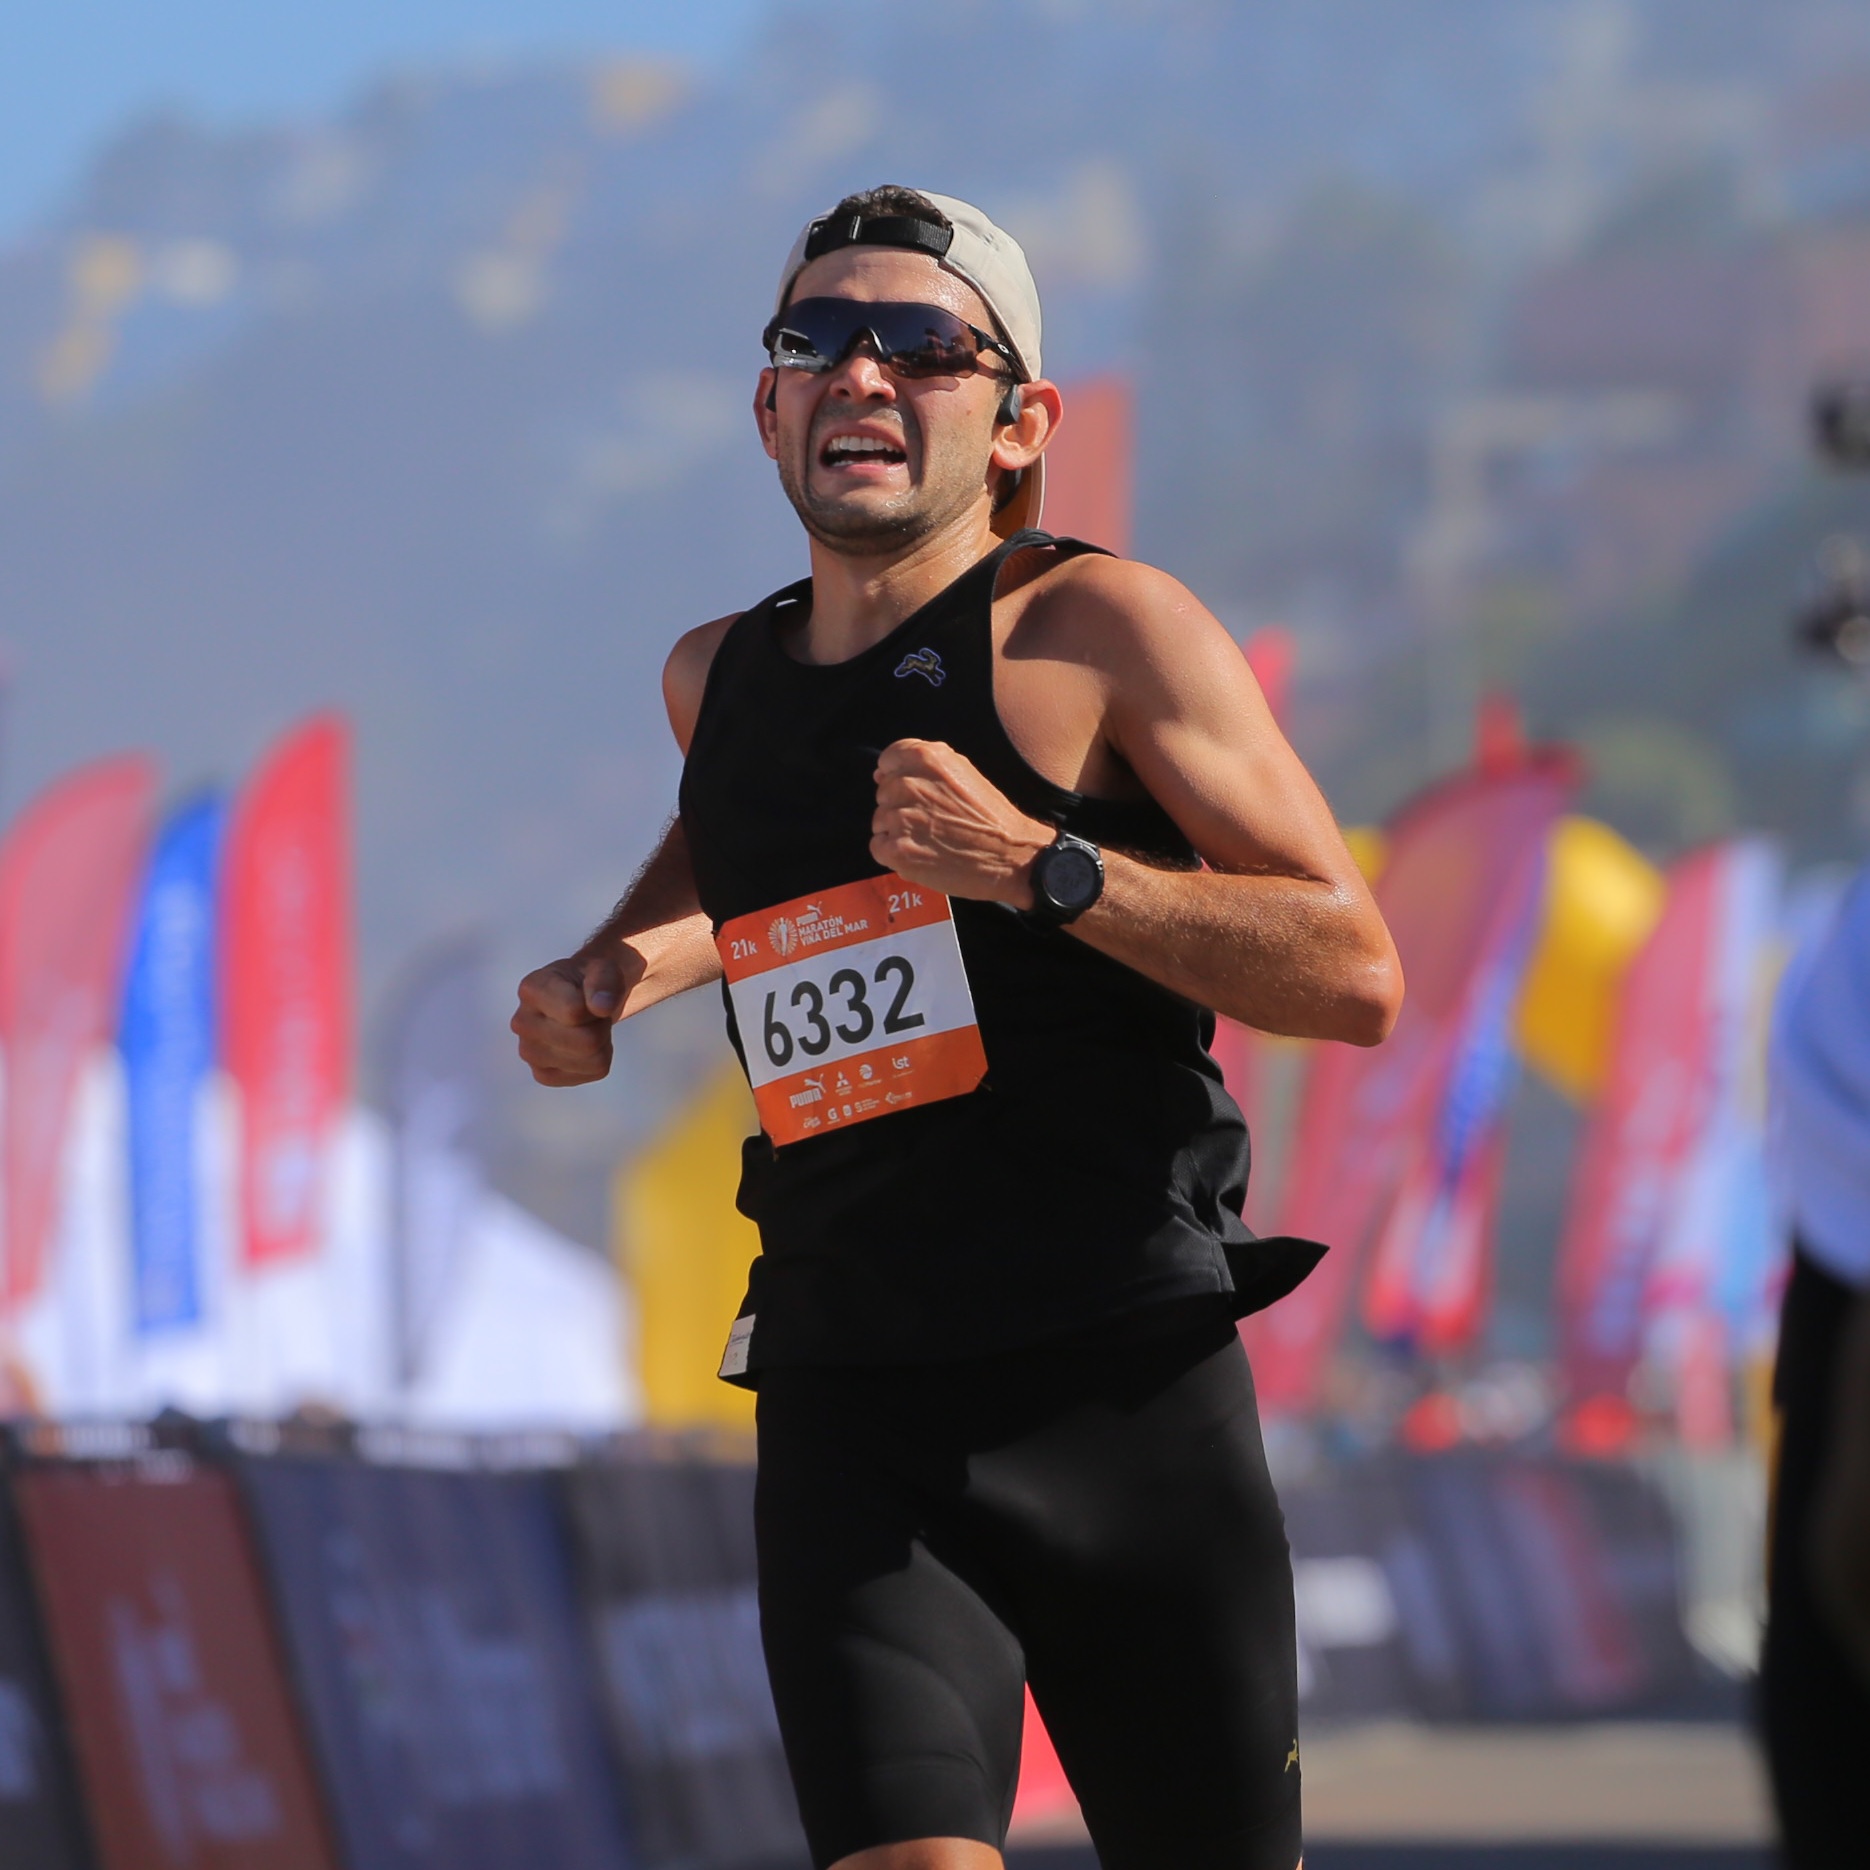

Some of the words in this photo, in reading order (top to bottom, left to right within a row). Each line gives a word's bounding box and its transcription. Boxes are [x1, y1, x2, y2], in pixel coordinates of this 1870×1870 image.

[888, 891, 923, 913] 21k
[798, 916, 843, 937] MARATÓN
[823, 928, 843, 940] DEL
[844, 919, 868, 934] MAR
[730, 938, 758, 960] 21k
[764, 955, 925, 1067] 6332
[789, 1088, 822, 1109] PUMA
